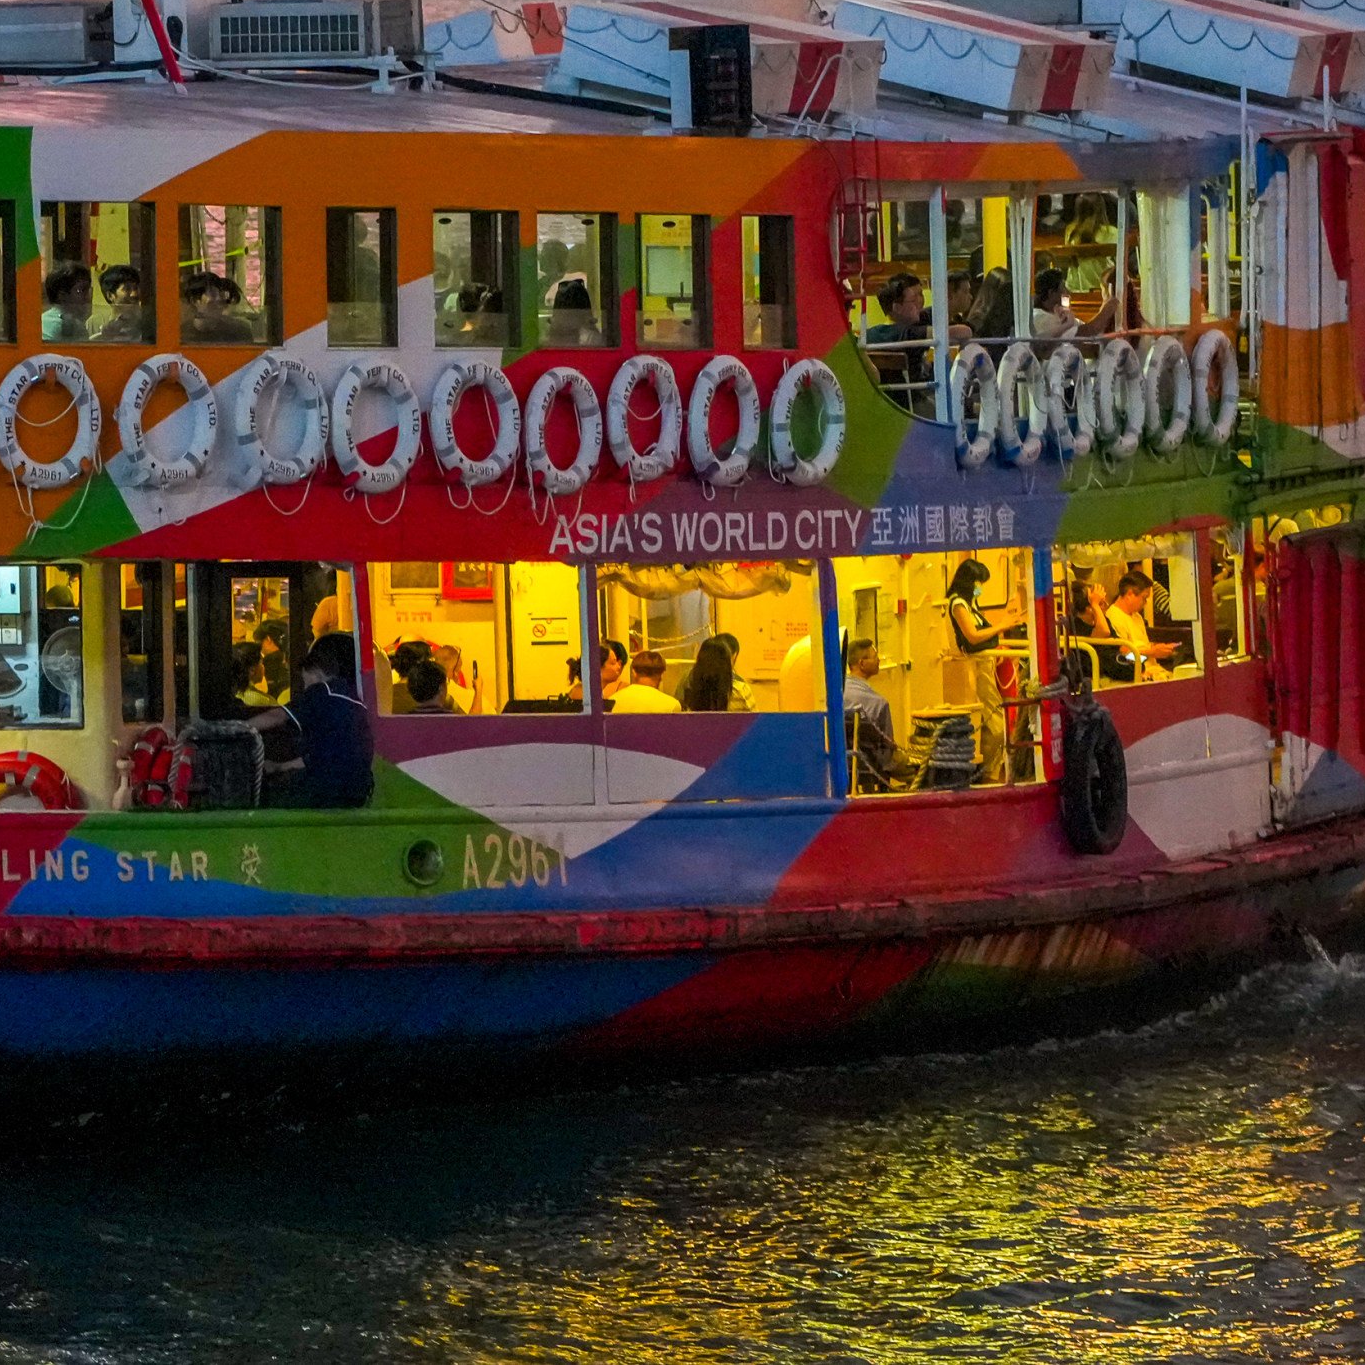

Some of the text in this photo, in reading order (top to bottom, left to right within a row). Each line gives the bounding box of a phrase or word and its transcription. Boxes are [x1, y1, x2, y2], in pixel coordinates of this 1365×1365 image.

[134, 379, 149, 409] STAR
[254, 368, 271, 395] STAR
[447, 378, 461, 407] STAR
[5, 416, 13, 442] THE
[9, 376, 28, 404] STAR
[346, 386, 358, 416] STAR
[134, 422, 143, 448] THE
[30, 467, 62, 480] A2961
[160, 468, 188, 479] A2961
[548, 509, 863, 554] ASIA'S WORLD CITY
[870, 505, 1017, 546] 亞洲國際都會
[116, 849, 210, 883] STAR
[462, 832, 568, 889] A2961
